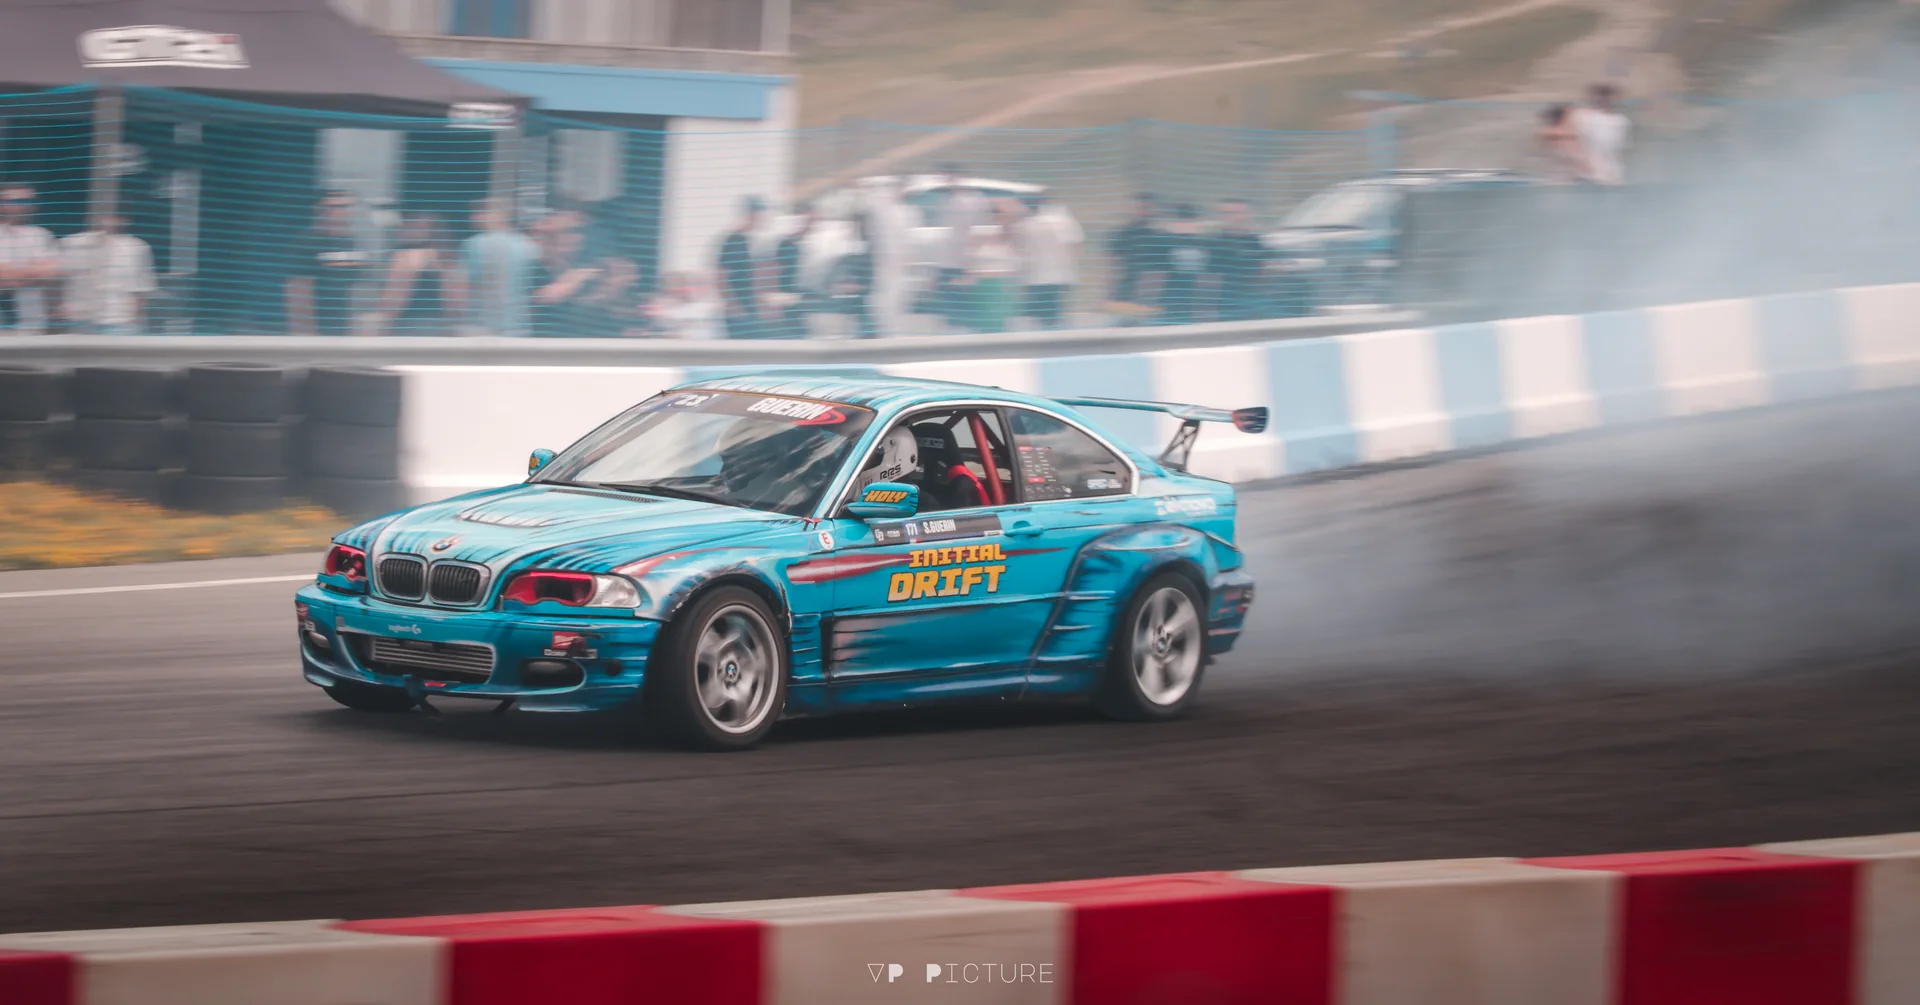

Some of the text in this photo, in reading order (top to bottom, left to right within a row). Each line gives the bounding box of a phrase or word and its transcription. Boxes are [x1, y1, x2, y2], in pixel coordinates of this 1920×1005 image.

[747, 397, 833, 420] GUERIN
[880, 464, 902, 480] RRS
[864, 490, 908, 504] HOLY
[905, 523, 918, 536] 171
[923, 519, 957, 534] S.GUERIN
[909, 543, 1007, 568] INITIAL
[887, 565, 1006, 602] DRIFT
